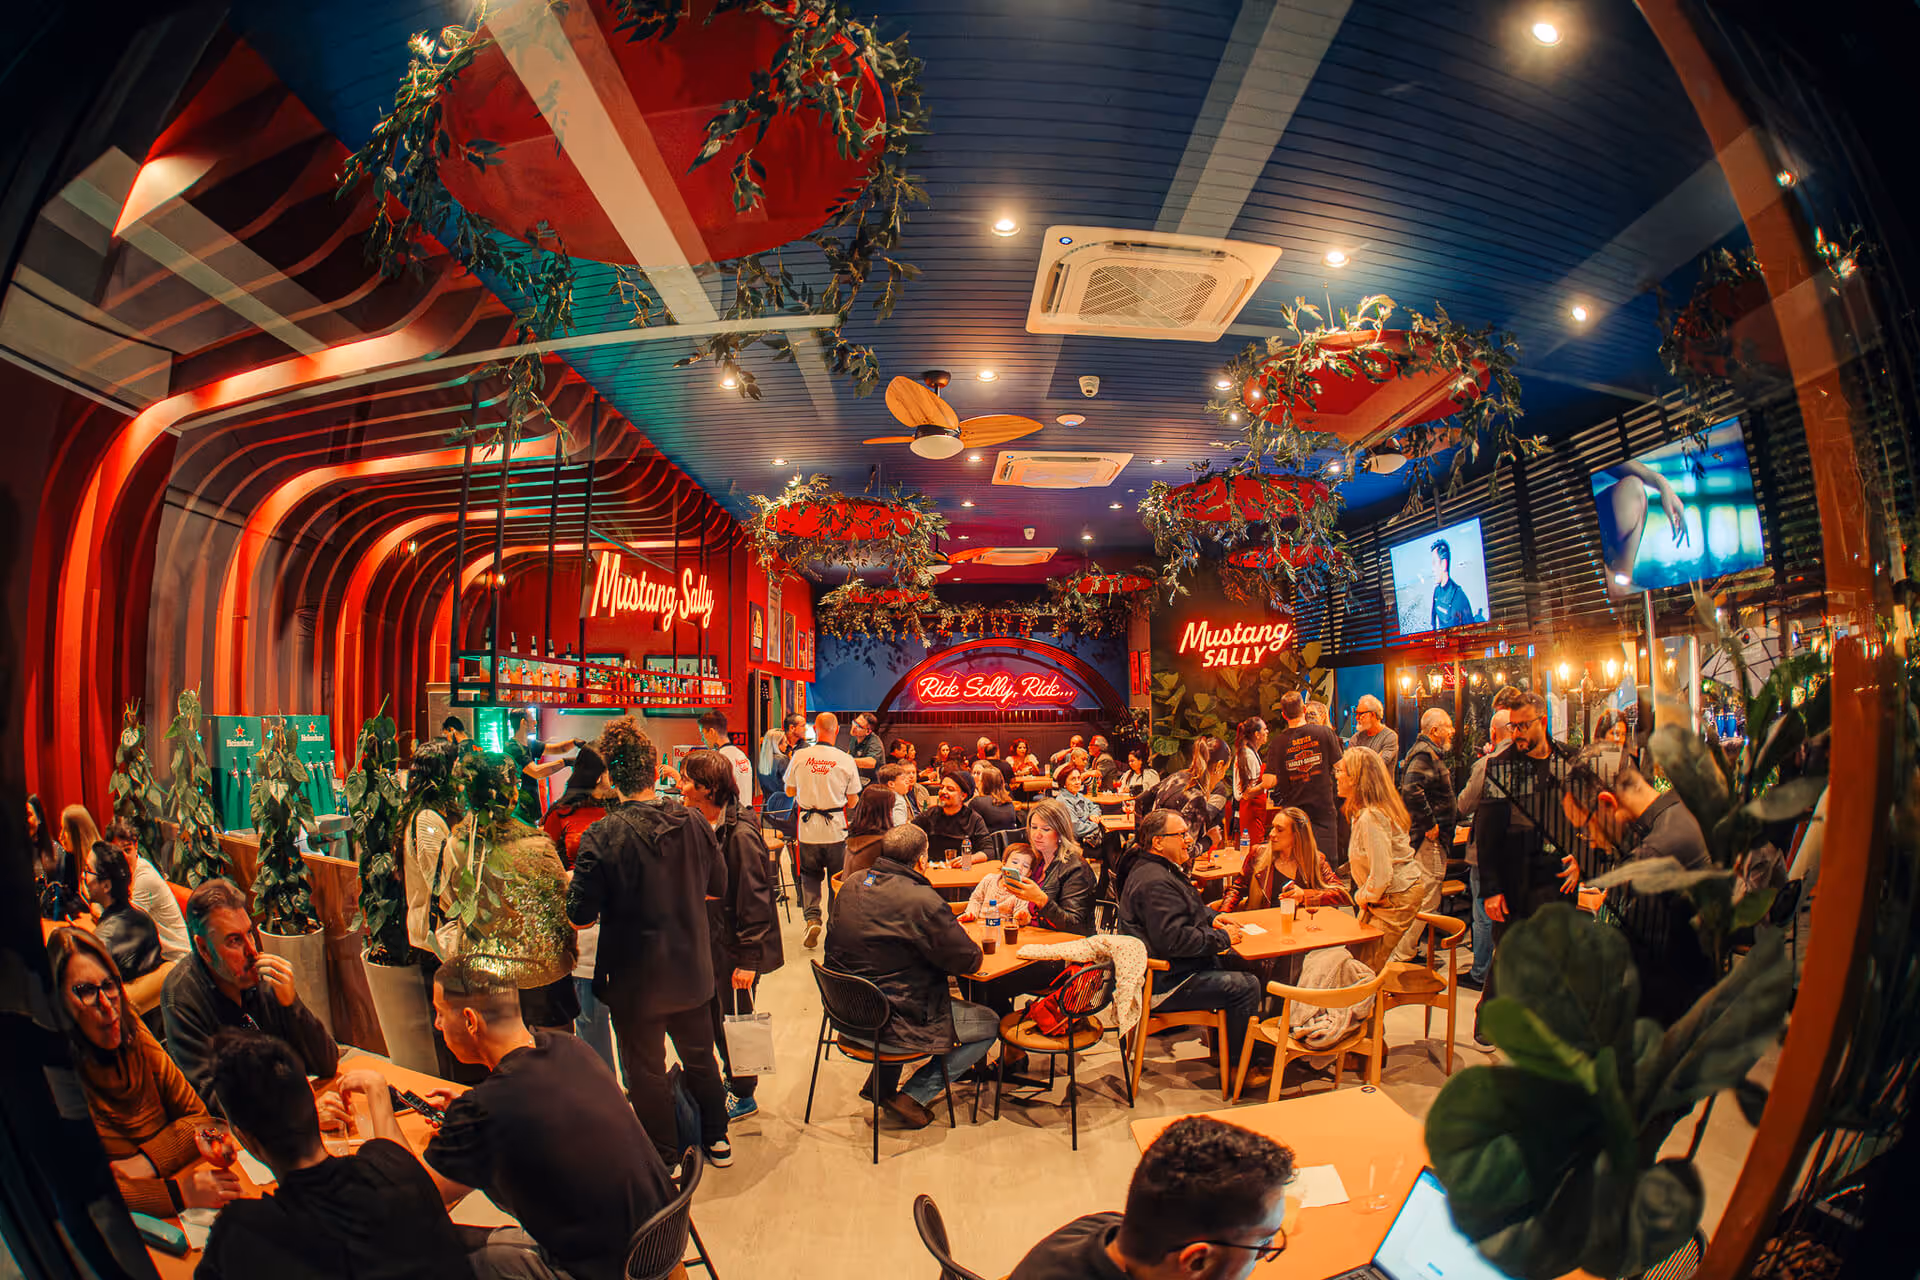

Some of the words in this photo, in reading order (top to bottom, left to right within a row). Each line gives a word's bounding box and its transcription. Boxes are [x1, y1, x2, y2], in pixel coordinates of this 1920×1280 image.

[591, 551, 678, 632] Mustang
[680, 568, 714, 629] Sally
[1179, 621, 1293, 653] Mustang
[1202, 645, 1267, 668] SALLY
[919, 676, 960, 698] Ride
[963, 675, 1019, 704] Sally,
[1021, 675, 1074, 698] Ride...
[226, 738, 254, 747] Heineken
[805, 757, 837, 768] Mustang
[811, 765, 830, 776] Sally
